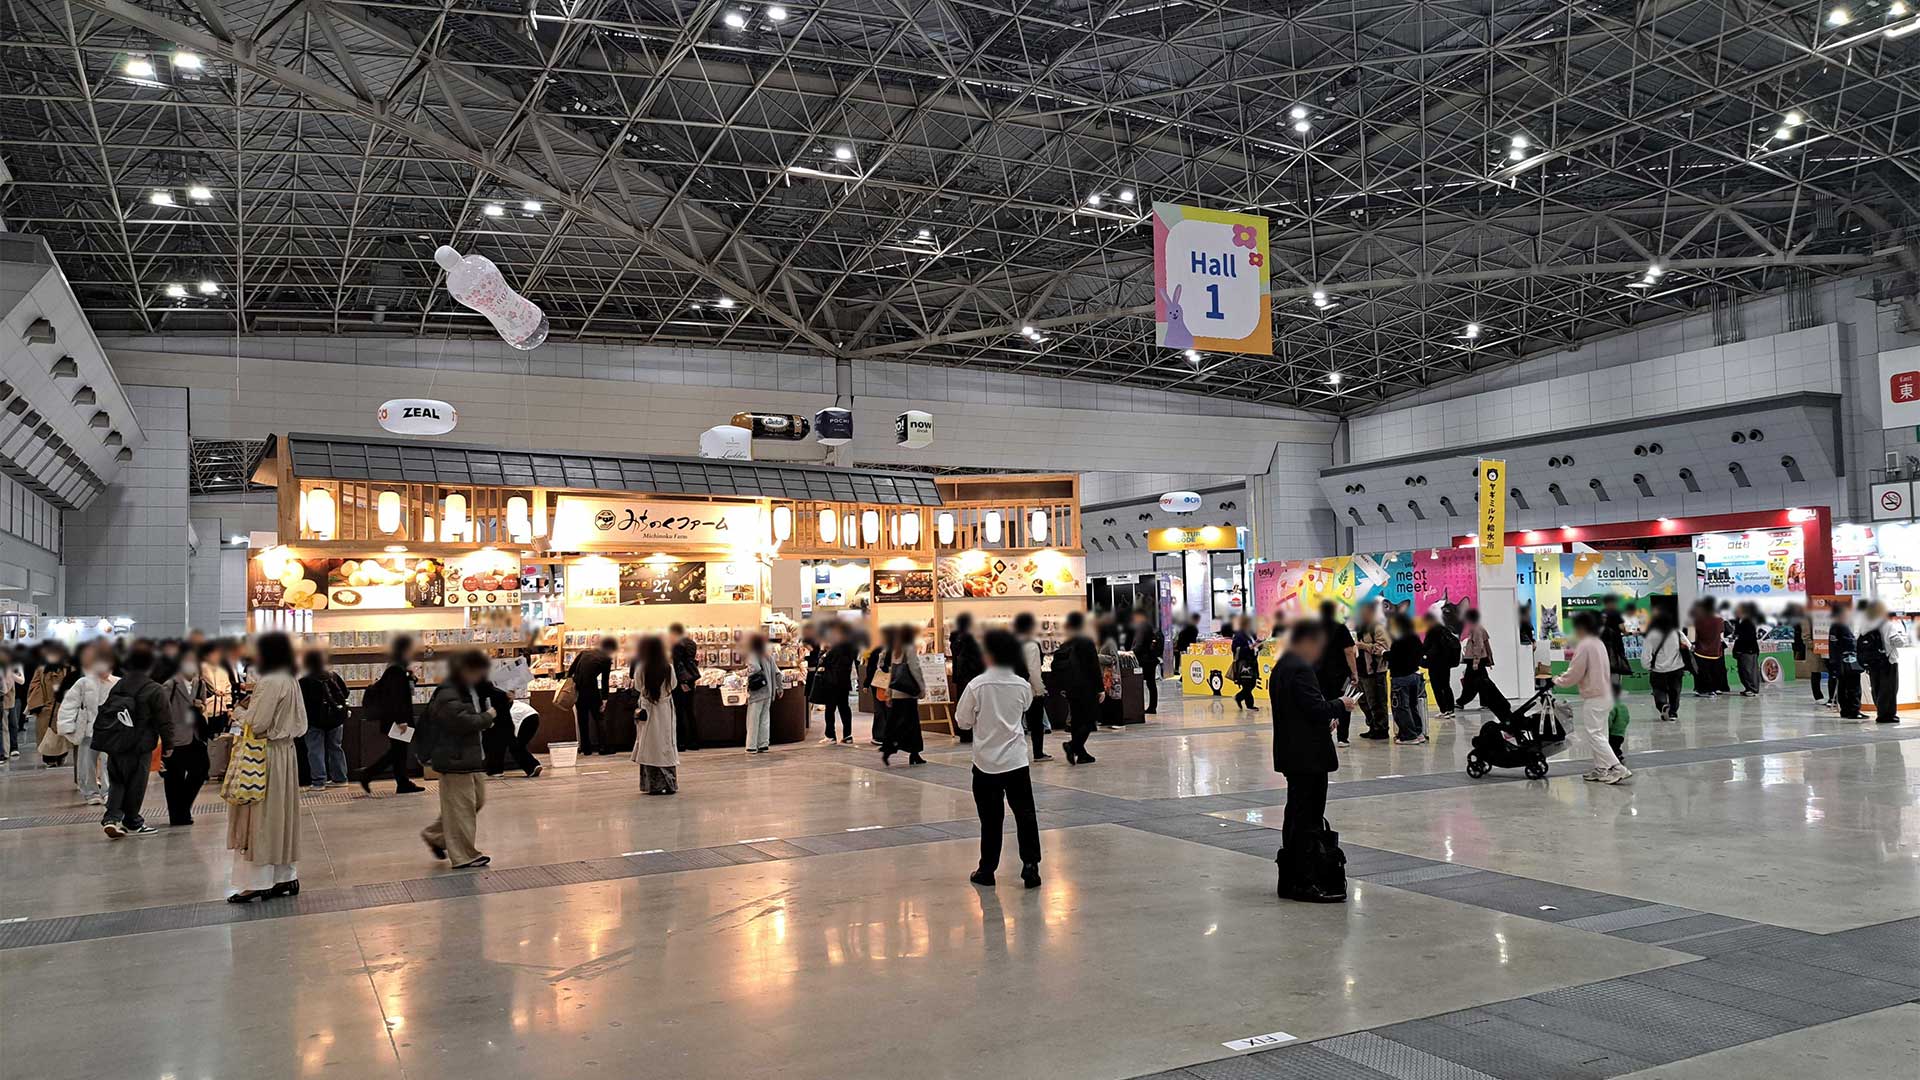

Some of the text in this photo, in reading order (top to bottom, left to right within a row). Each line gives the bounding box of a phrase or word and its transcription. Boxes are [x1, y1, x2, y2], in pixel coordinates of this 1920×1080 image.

[1191, 251, 1237, 278] Hall
[1206, 284, 1224, 319] 1
[1899, 383, 1914, 399] 東
[403, 407, 440, 419] ZEAL
[911, 421, 932, 429] now
[618, 509, 728, 534] みちのくファーム
[1487, 483, 1495, 550] ヤギミルク給水所
[1396, 569, 1427, 581] meat
[1598, 567, 1648, 578] zealandia
[653, 580, 670, 592] 27
[1397, 581, 1427, 592] meet
[1241, 1036, 1279, 1047] FIX
